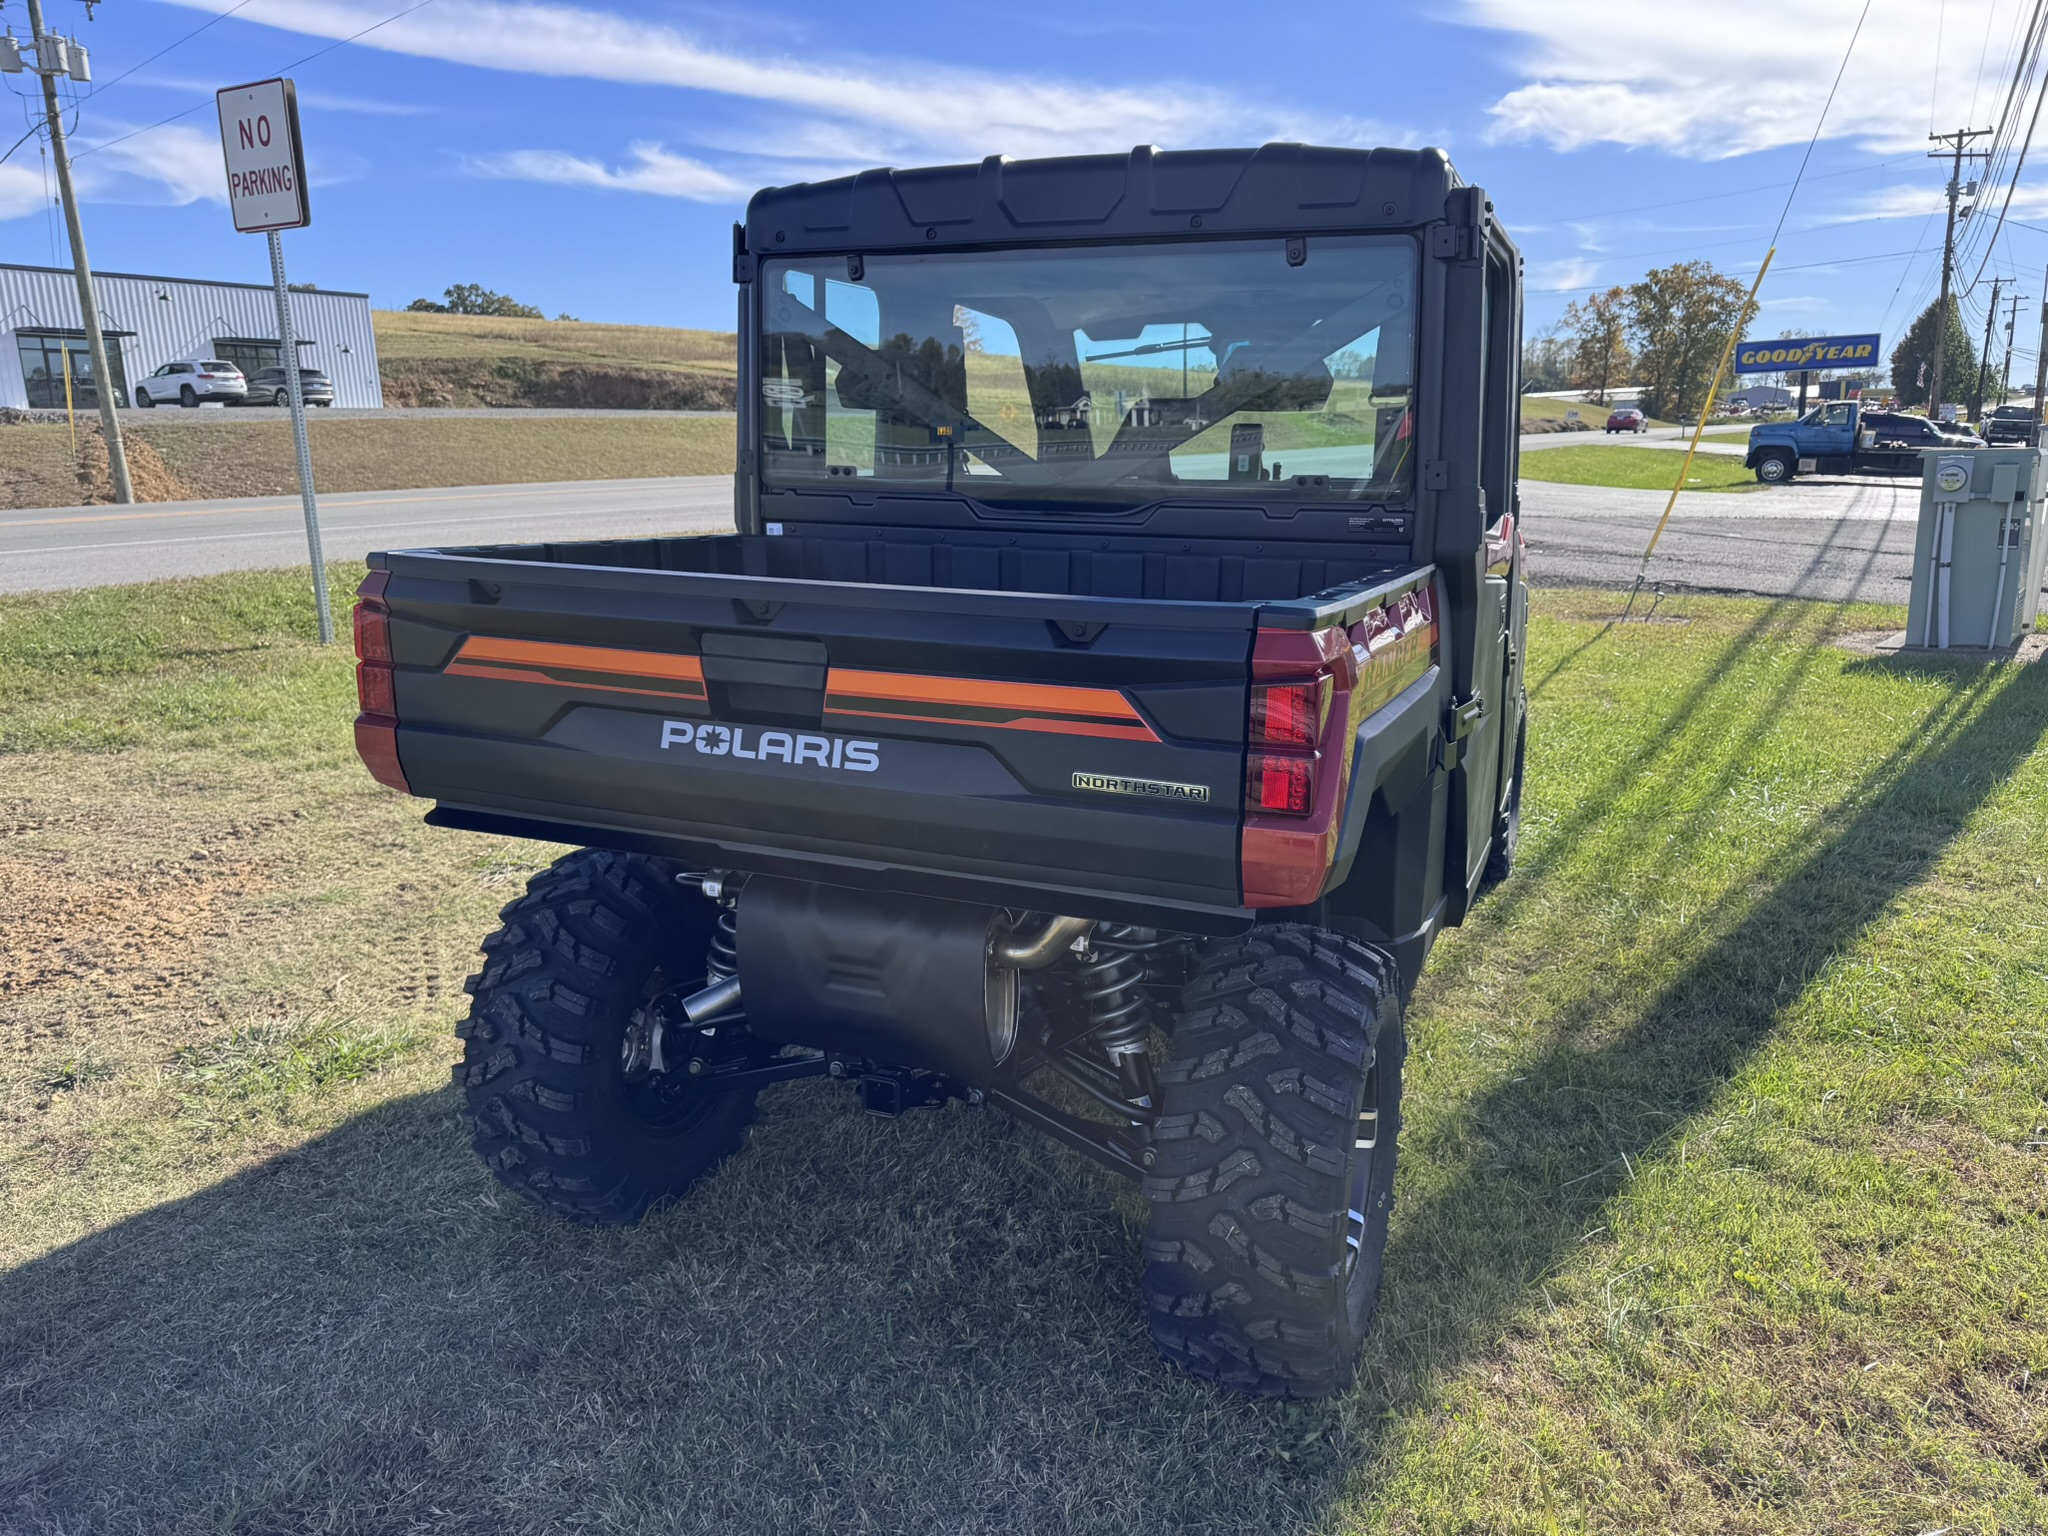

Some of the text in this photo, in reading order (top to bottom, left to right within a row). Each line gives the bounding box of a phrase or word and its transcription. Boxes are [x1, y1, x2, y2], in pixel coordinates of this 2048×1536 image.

[238, 115, 271, 150] NO
[231, 165, 293, 199] PARKING
[1741, 344, 1872, 365] GOODYEAR
[660, 720, 880, 772] POLARIS
[1077, 776, 1202, 800] NORTHSTAR
